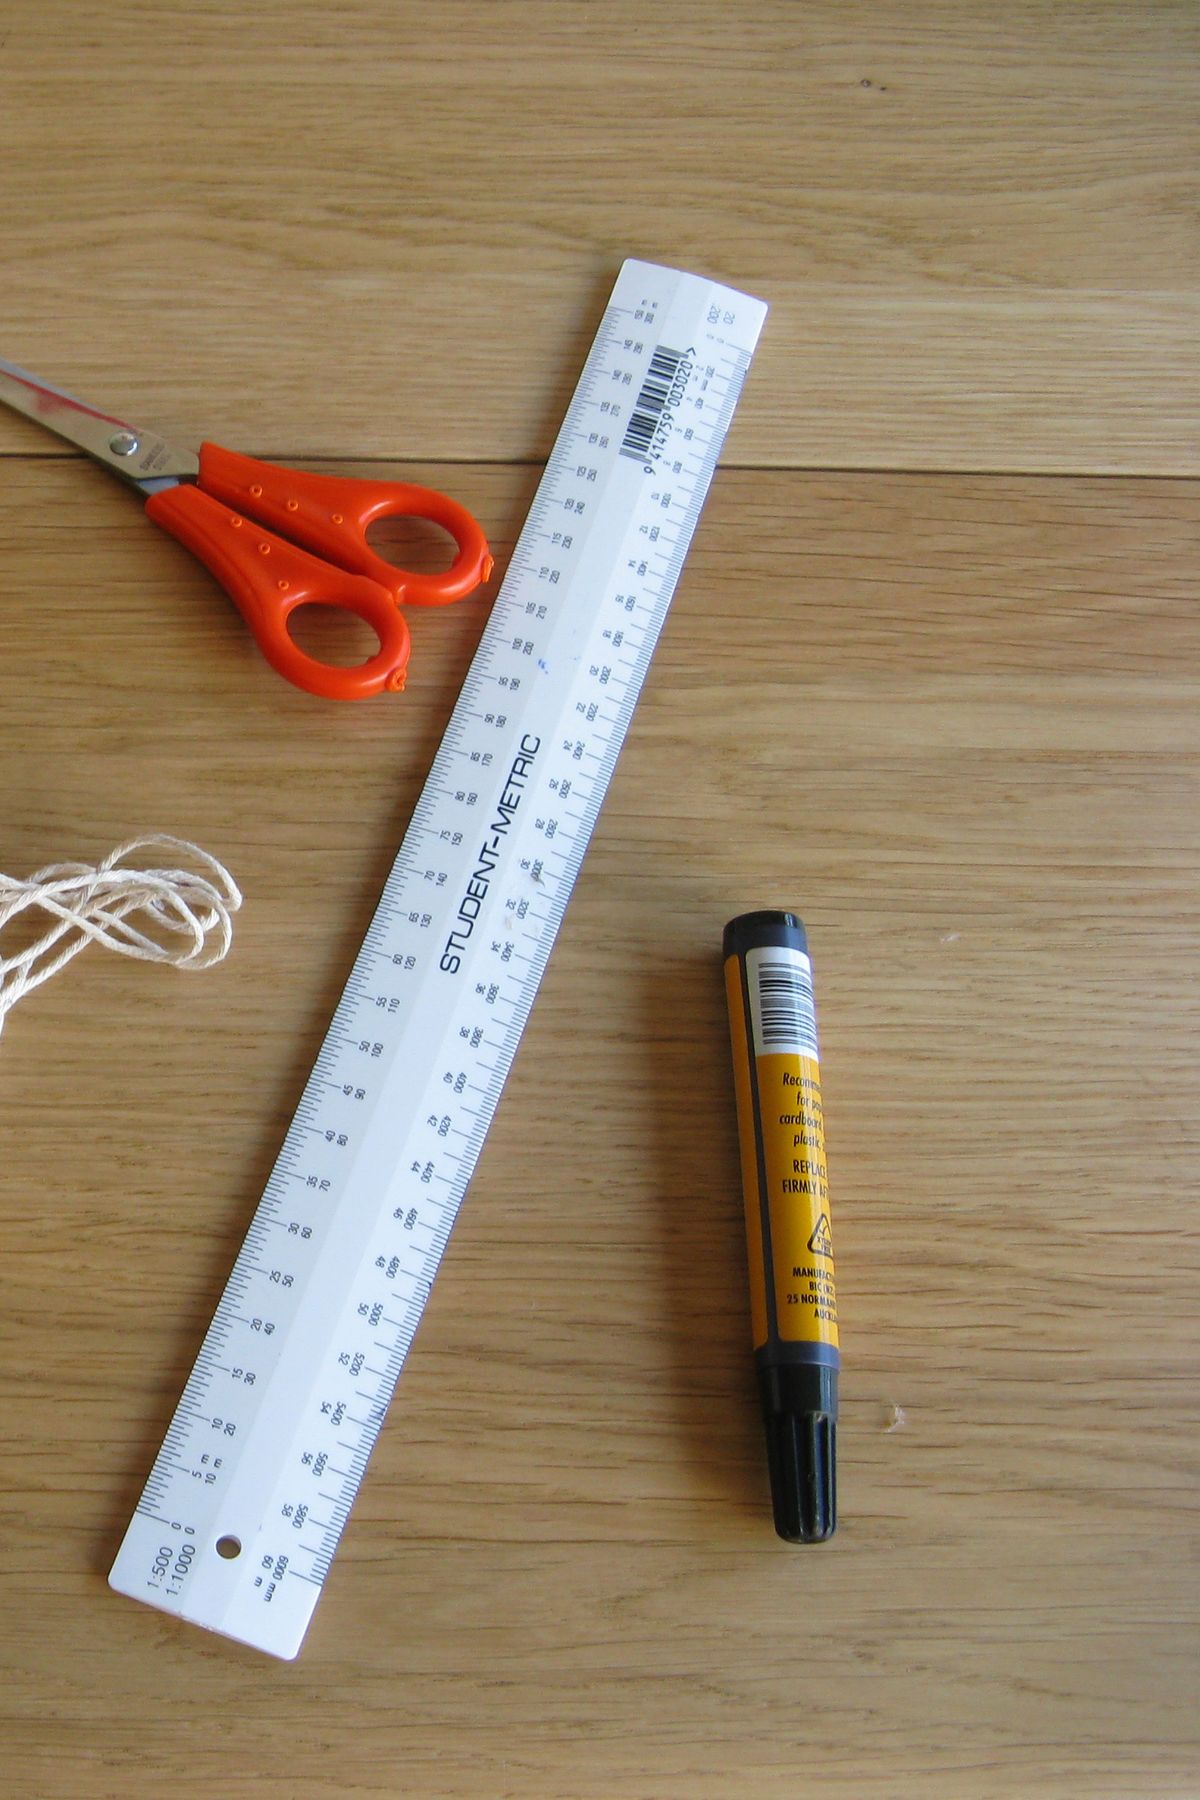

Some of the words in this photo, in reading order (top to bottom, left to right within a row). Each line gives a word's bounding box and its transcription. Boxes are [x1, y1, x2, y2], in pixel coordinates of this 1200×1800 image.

[650, 413, 675, 460] 414759
[666, 359, 693, 407] 003020
[575, 701, 587, 713] 22
[585, 702, 599, 722] 2200
[562, 739, 573, 752] 24
[572, 740, 586, 761] 2400
[548, 778, 560, 791] 26
[558, 778, 572, 799] 2600
[534, 817, 546, 830] 28
[544, 818, 559, 839] 2800
[438, 733, 541, 974] STUDENT-METRIC
[518, 857, 531, 870] 30
[505, 898, 517, 911] 32
[515, 897, 530, 920] 3200
[490, 940, 502, 953] 34
[500, 940, 515, 963] 3400
[475, 982, 487, 995] 36
[485, 982, 500, 1005] 3600
[459, 1025, 471, 1039] 38
[469, 1026, 484, 1049] 3800
[442, 1071, 454, 1084] 40
[452, 1071, 468, 1094] 4000
[796, 1090, 809, 1107] for
[426, 1114, 439, 1127] 42
[437, 1114, 453, 1137] 4200
[146, 1545, 173, 1588] 1:500
[211, 1417, 224, 1430] 10
[231, 1367, 244, 1379] 15
[250, 1317, 263, 1332] 20
[268, 1269, 282, 1284] 25
[287, 1222, 300, 1235] 30
[306, 1175, 319, 1188] 35
[324, 1129, 336, 1143] 40
[342, 1084, 354, 1096] 45
[358, 1040, 371, 1053] 50
[375, 995, 388, 1008] 55
[392, 953, 404, 965] 60
[408, 911, 420, 923] 65
[423, 869, 436, 881] 70
[439, 829, 451, 841] 75
[454, 790, 466, 802] 80
[469, 751, 481, 762] 85
[484, 713, 496, 724] 90
[497, 675, 509, 687] 95
[165, 1543, 196, 1595] 1:1000
[204, 1472, 217, 1485] 10
[223, 1422, 237, 1437] 20
[243, 1371, 257, 1386] 30
[263, 1322, 276, 1336] 40
[281, 1274, 295, 1288] 50
[300, 1226, 313, 1239] 60
[318, 1179, 331, 1192] 70
[336, 1133, 349, 1147] 80
[354, 1088, 366, 1101] 90
[370, 1042, 384, 1058] 100
[387, 997, 401, 1013] 110
[403, 955, 417, 970] 120
[419, 913, 433, 928] 130
[435, 872, 448, 887] 140
[450, 831, 464, 846] 150
[466, 791, 479, 806] 160
[481, 752, 494, 767] 170
[495, 714, 508, 728] 180
[509, 677, 521, 691] 190
[410, 1160, 422, 1173] 44
[420, 1160, 436, 1184] 4400
[782, 1178, 817, 1196] FIRMLY
[392, 1206, 405, 1220] 46
[403, 1207, 419, 1231] 4600
[374, 1255, 387, 1269] 48
[385, 1255, 401, 1279] 4800
[809, 1281, 822, 1292] BIC
[786, 1293, 799, 1305] 25
[357, 1302, 370, 1316] 50
[367, 1301, 384, 1327] 5000
[337, 1351, 351, 1366] 52
[348, 1351, 366, 1377] 5200
[320, 1400, 333, 1415] 54
[330, 1400, 347, 1426] 5400
[301, 1451, 314, 1466] 56
[311, 1451, 329, 1477] 5600
[281, 1503, 294, 1518] 58
[292, 1503, 309, 1529] 5800
[261, 1554, 274, 1570] 60
[272, 1554, 290, 1581] 6000
[263, 1581, 277, 1603] mm
